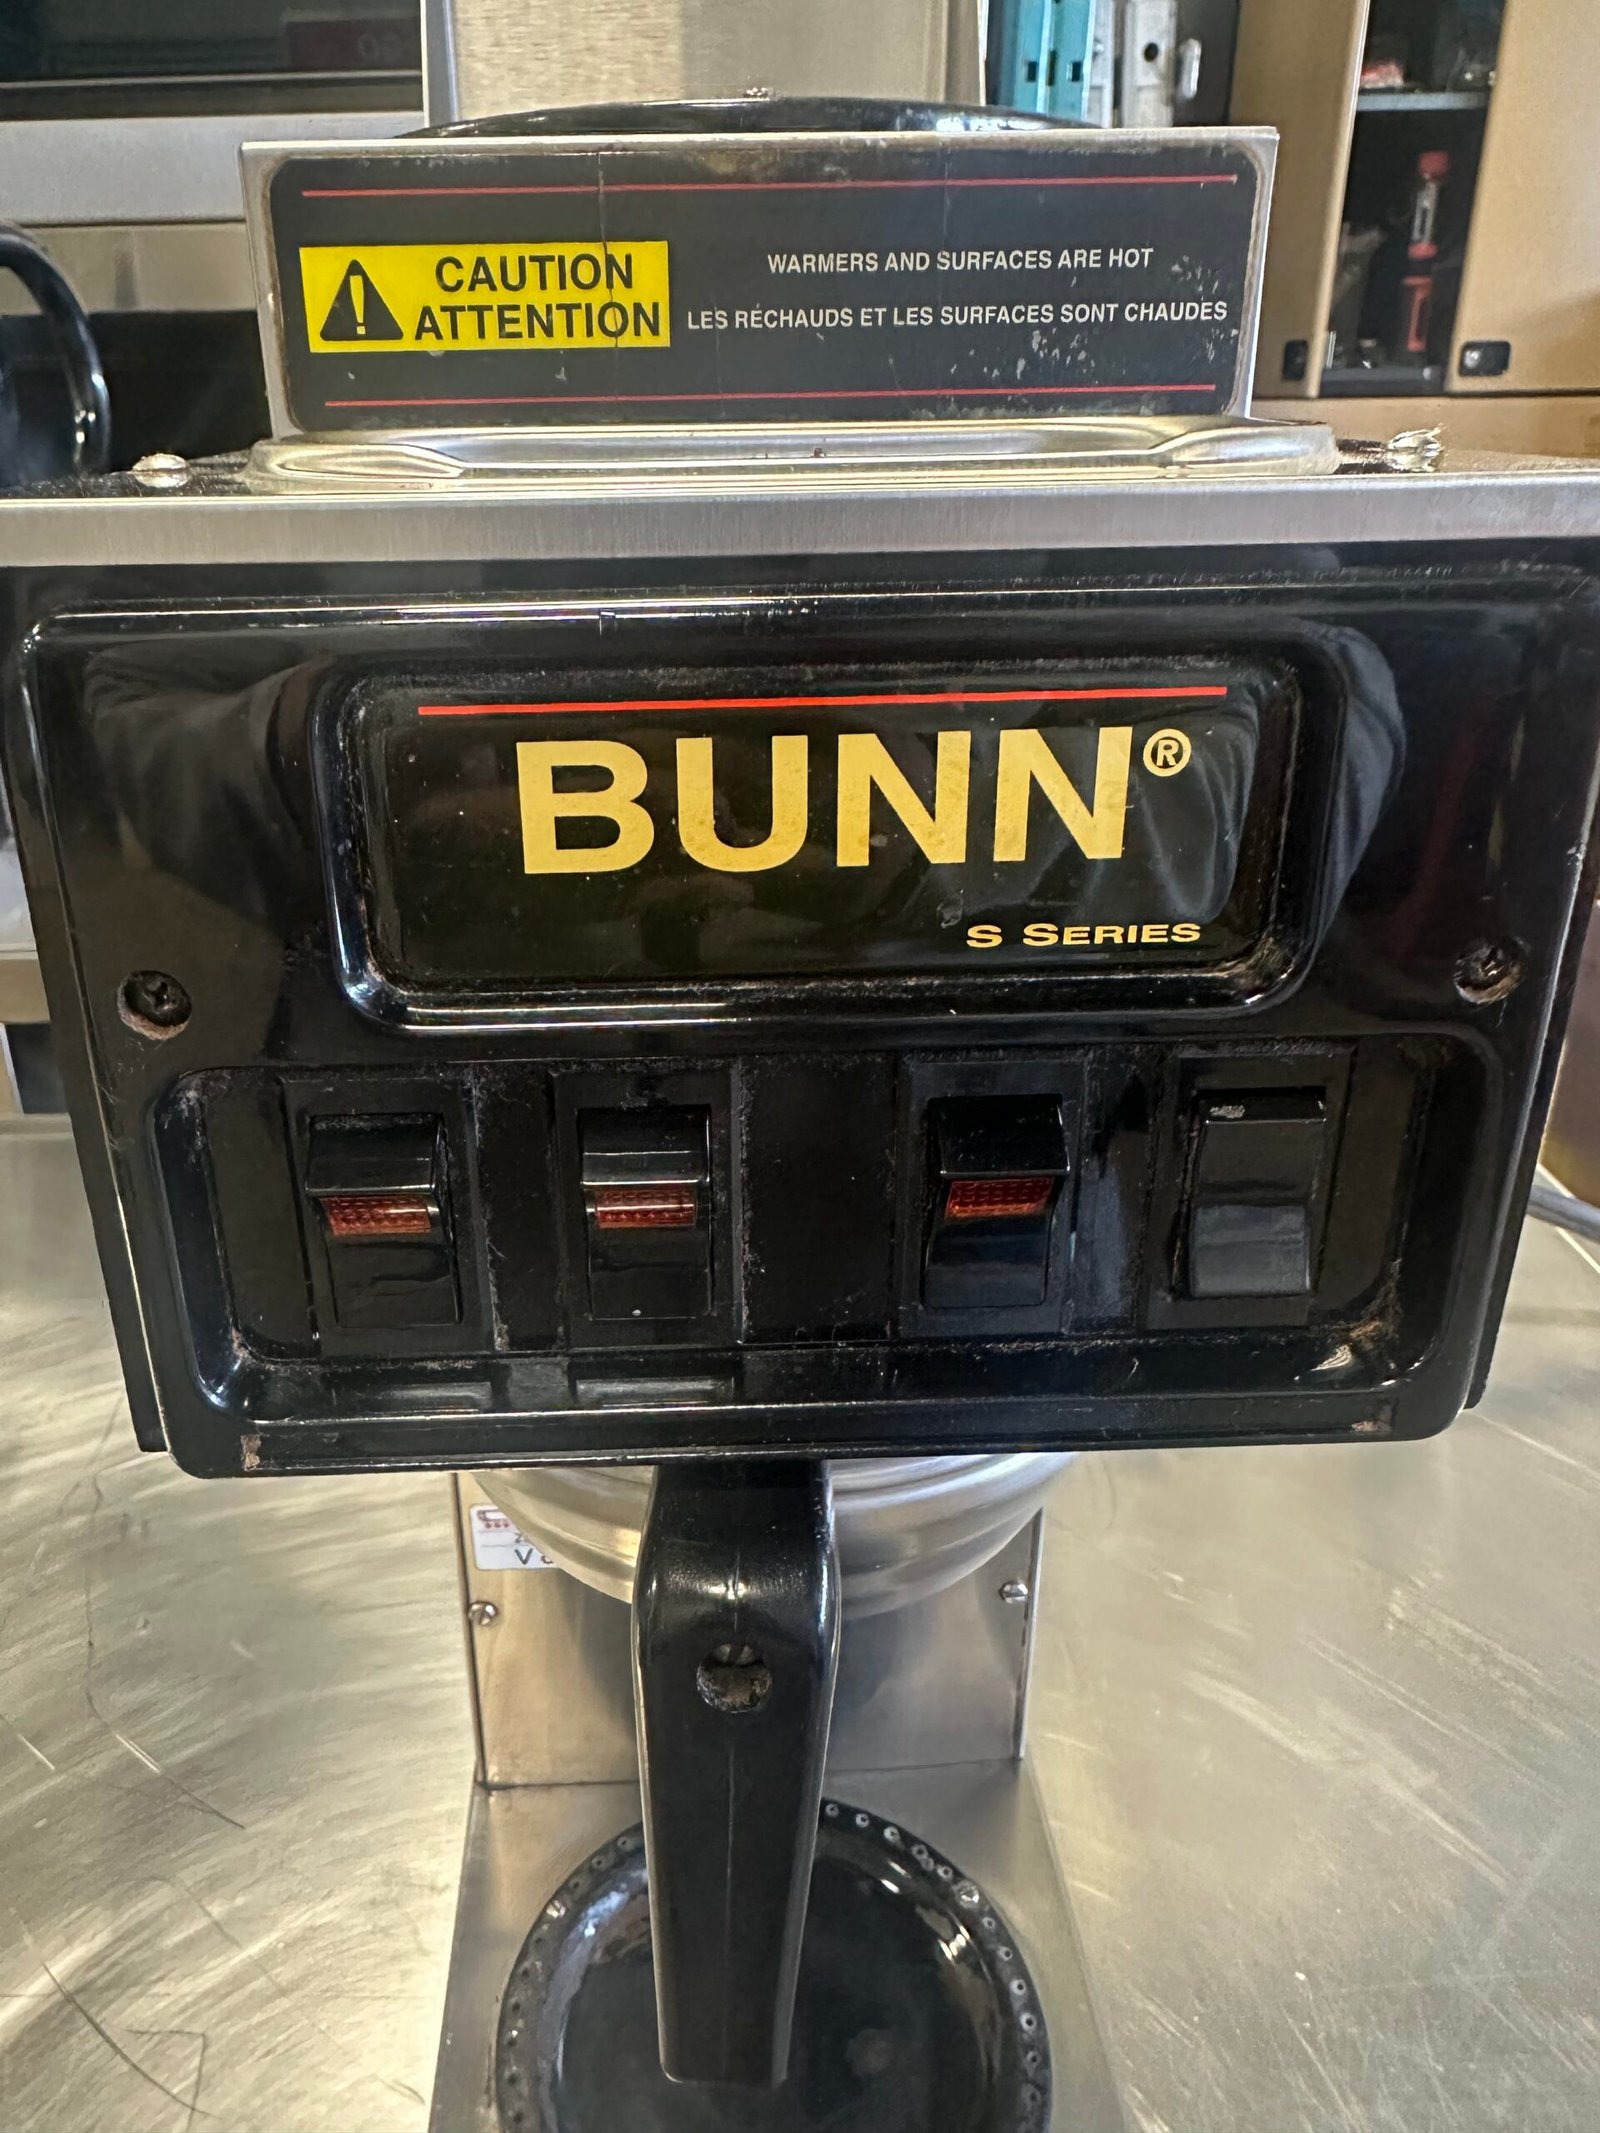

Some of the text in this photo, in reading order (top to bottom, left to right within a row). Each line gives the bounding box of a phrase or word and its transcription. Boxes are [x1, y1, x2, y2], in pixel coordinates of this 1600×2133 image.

[435, 252, 633, 293] CAUTION
[767, 247, 1154, 274] WARMERS AND SURFACES ARE HOT
[414, 301, 660, 341] ATTENTION
[687, 300, 1228, 330] LES RÉCHAUDS ET LES SURFACES SONT CHAUDES
[966, 924, 1003, 949] S
